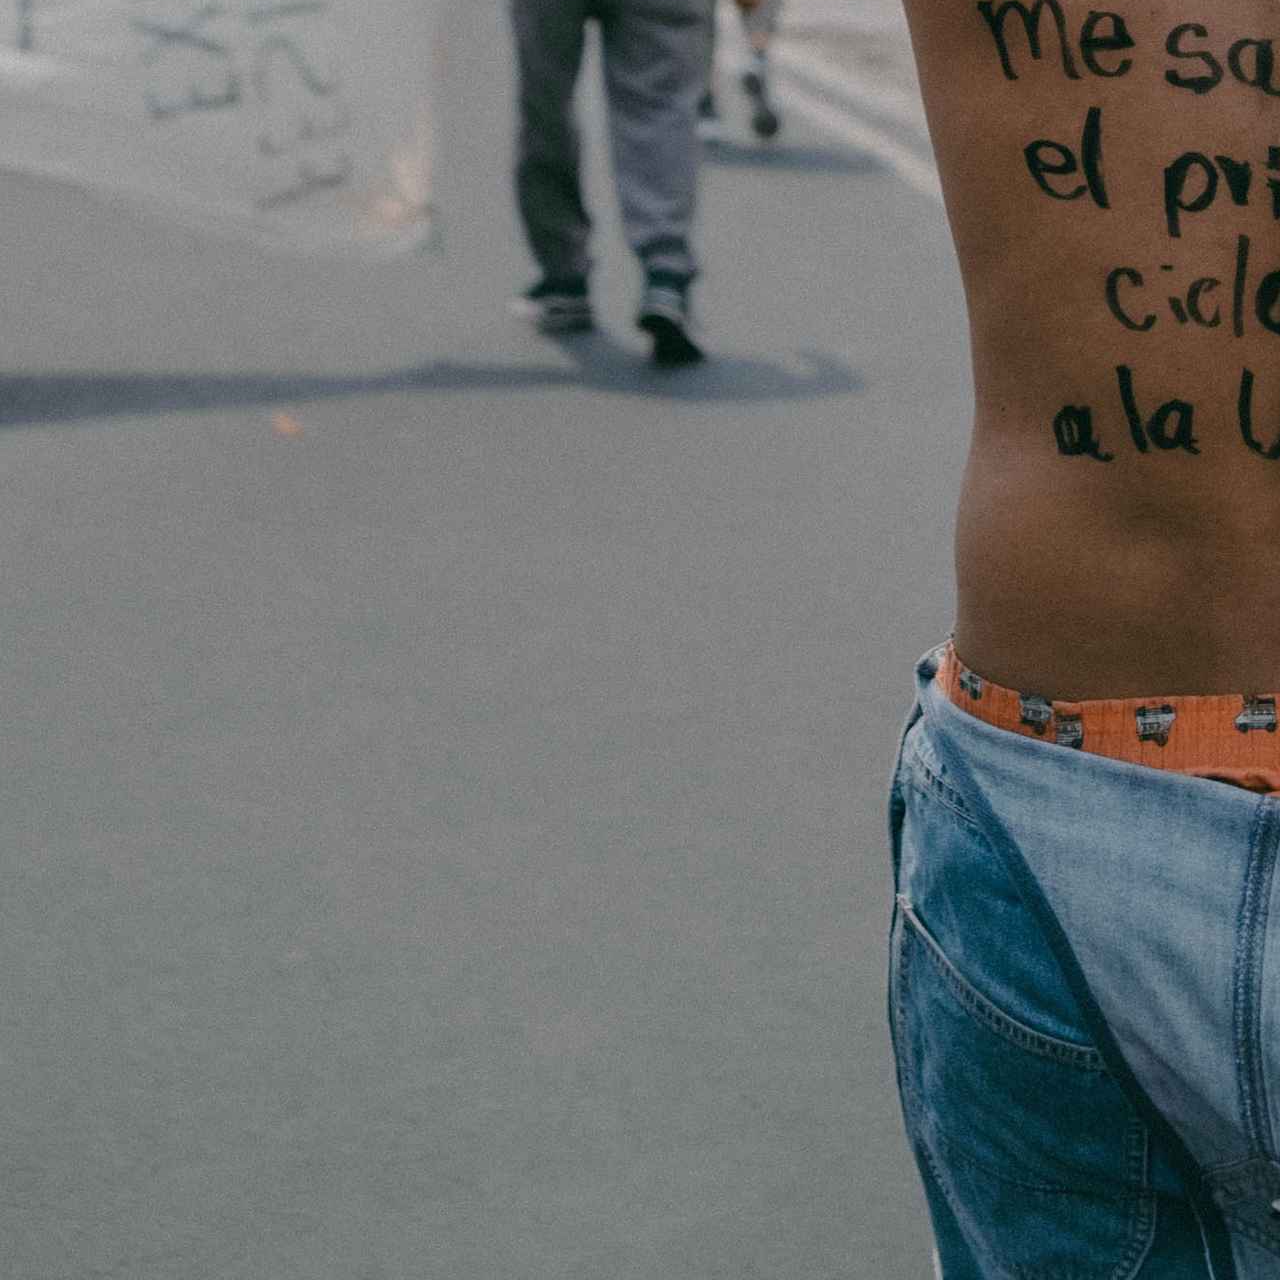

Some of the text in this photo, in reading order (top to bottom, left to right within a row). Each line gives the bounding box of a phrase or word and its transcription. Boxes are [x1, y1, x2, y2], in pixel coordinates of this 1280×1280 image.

[1023, 107, 1111, 209] el
[1052, 403, 1116, 463] a
[1115, 363, 1202, 457] la
